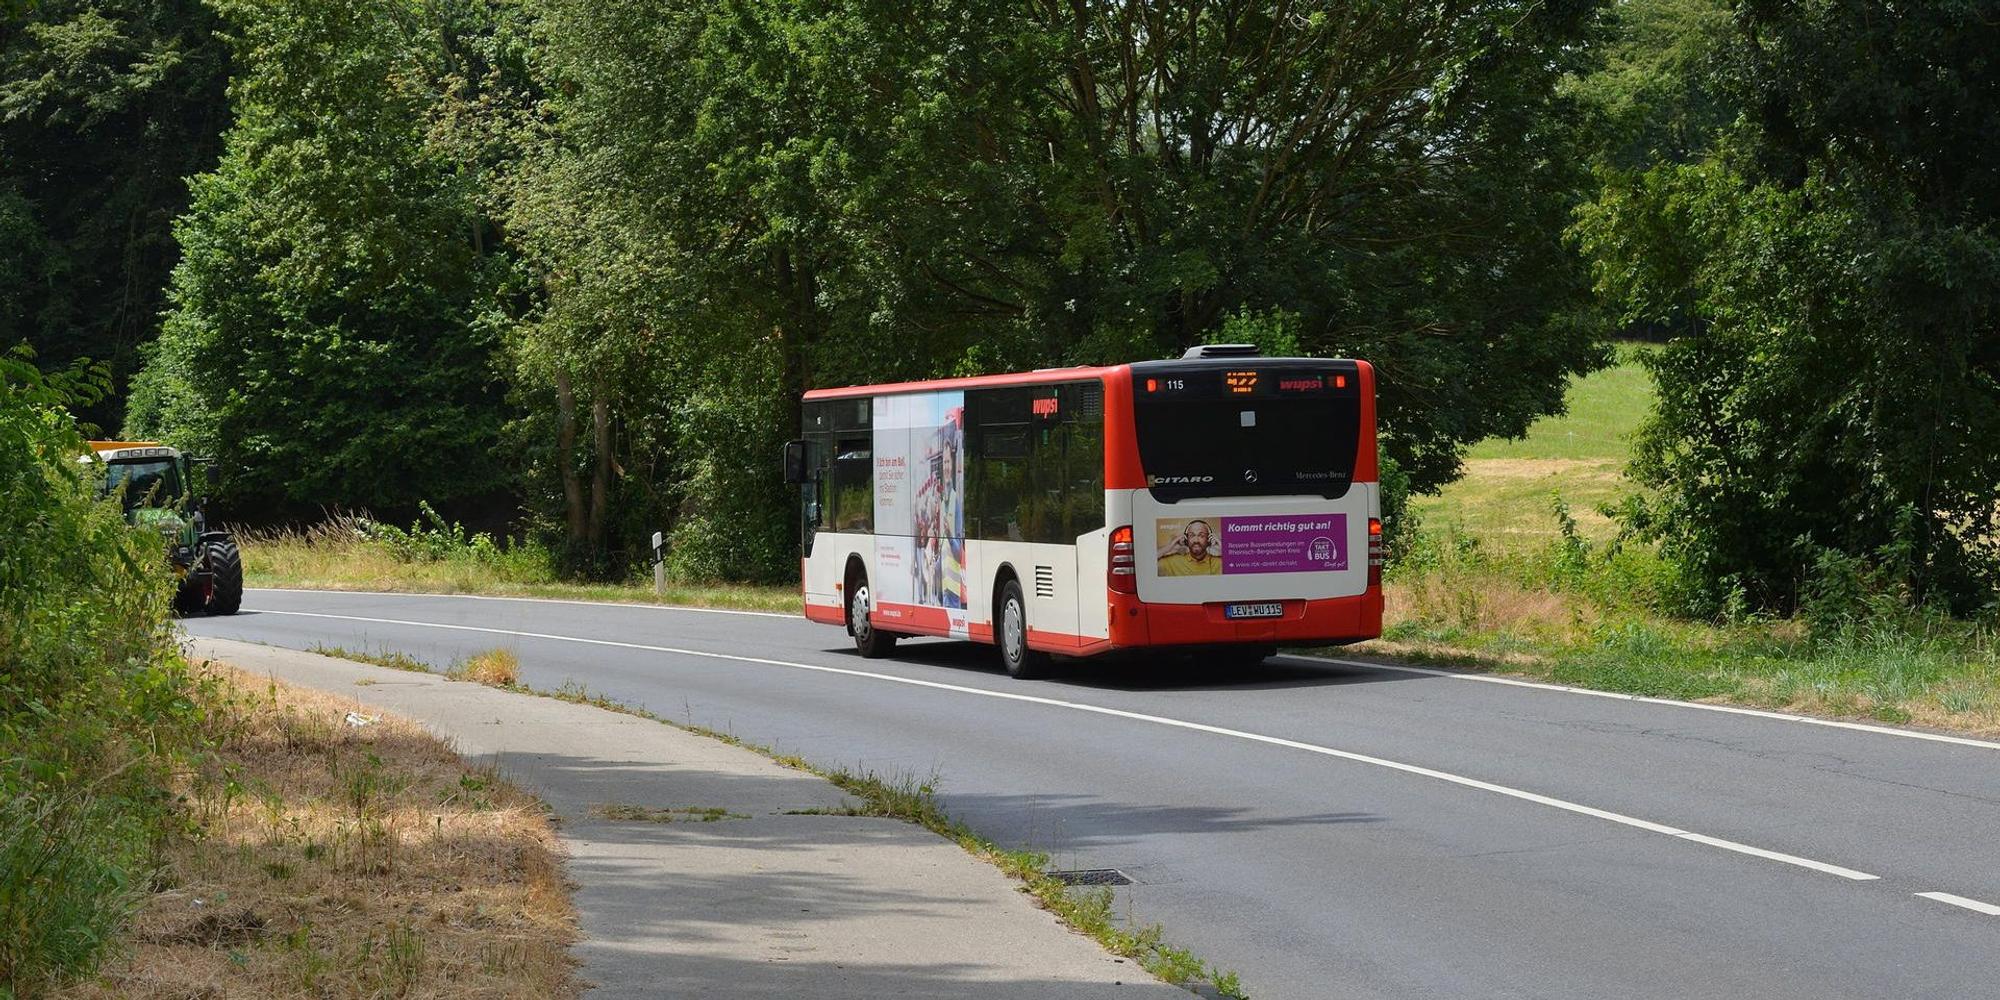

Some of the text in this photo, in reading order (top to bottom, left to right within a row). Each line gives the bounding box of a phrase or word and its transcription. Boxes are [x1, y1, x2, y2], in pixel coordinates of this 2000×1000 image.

[1167, 380, 1184, 390] 115
[1280, 376, 1322, 391] wupsi
[1033, 389, 1058, 419] wupsi
[1154, 475, 1214, 484] CITARO
[1296, 471, 1346, 480] Mercedes-Benz
[1228, 520, 1332, 533] Kommt richtig gut an!
[1314, 552, 1330, 560] BUS
[1232, 605, 1247, 616] LEV
[1265, 604, 1282, 614] 115
